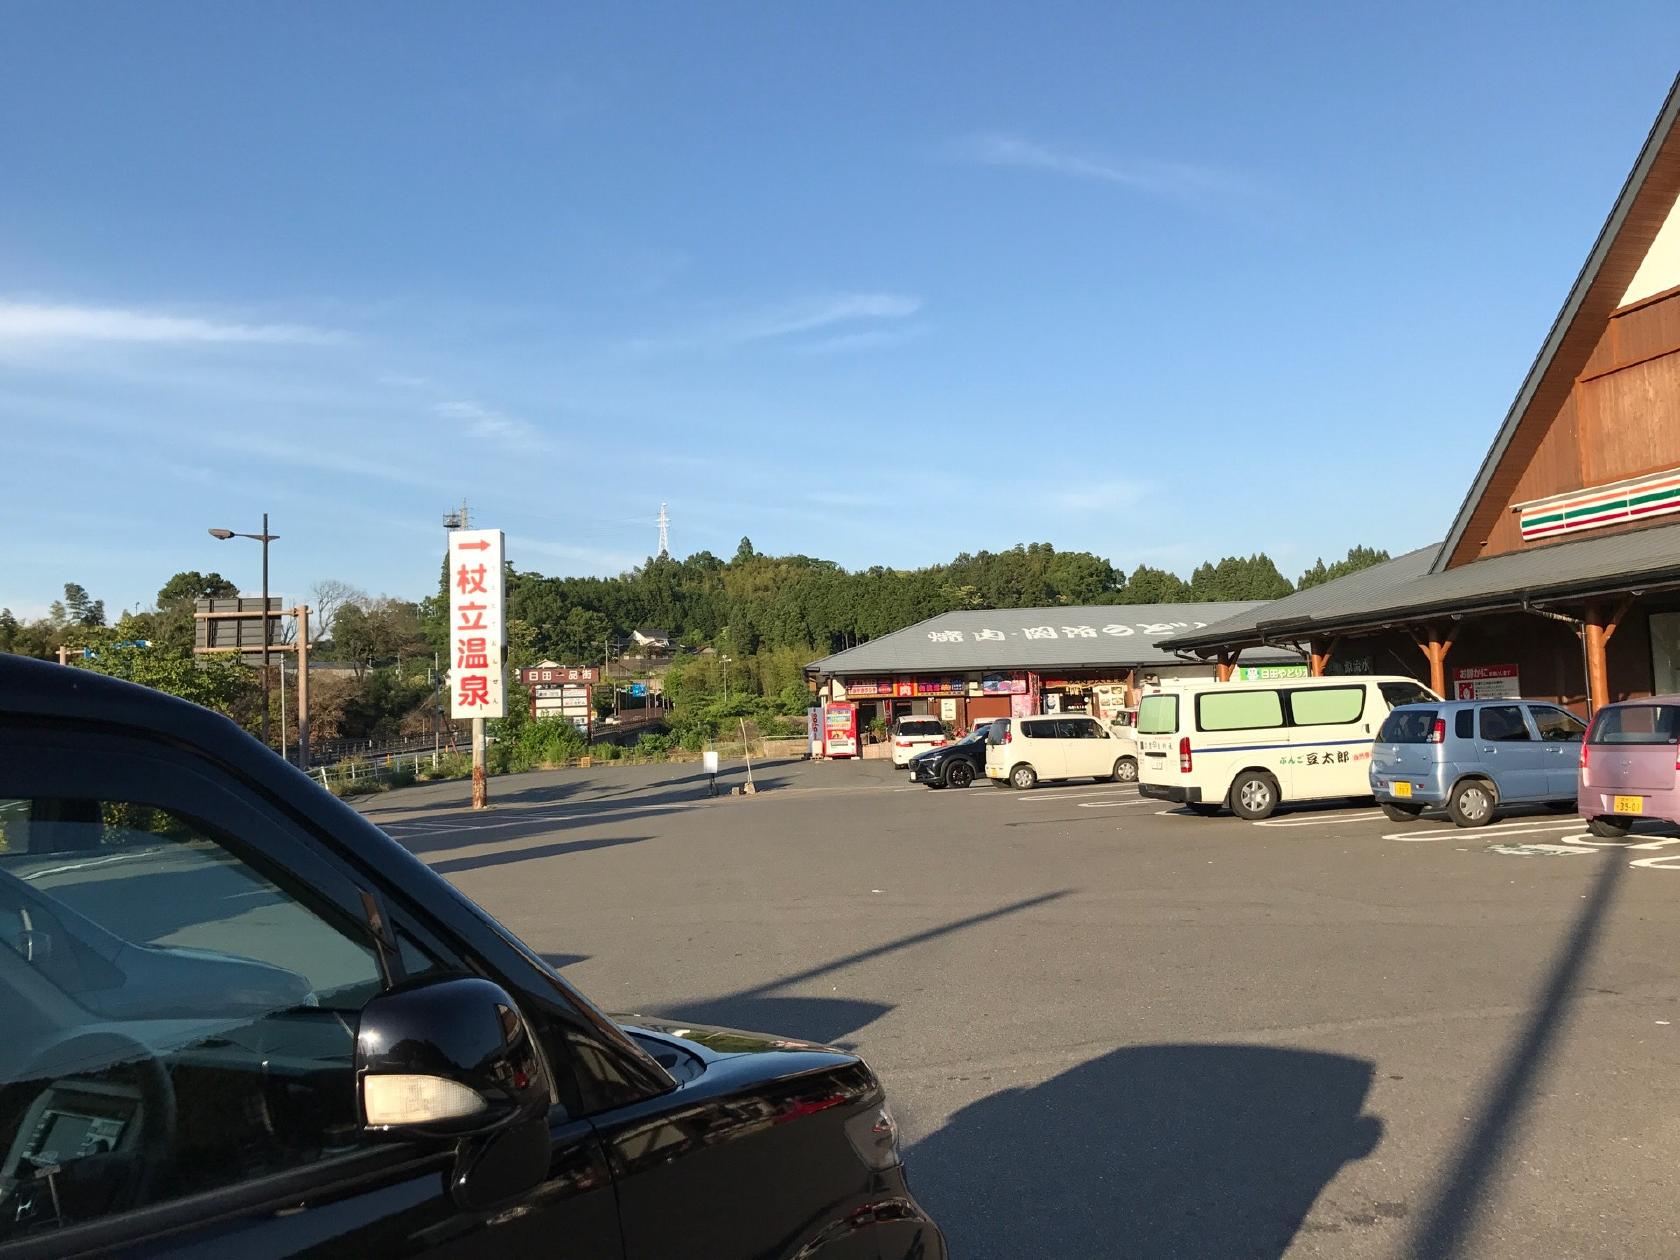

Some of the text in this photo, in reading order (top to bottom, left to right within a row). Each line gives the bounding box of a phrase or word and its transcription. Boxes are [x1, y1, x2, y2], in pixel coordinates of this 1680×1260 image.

[457, 563, 489, 706] 杖立温泉
[528, 669, 592, 681] 日田一品街
[1306, 750, 1350, 766] 豆太郎
